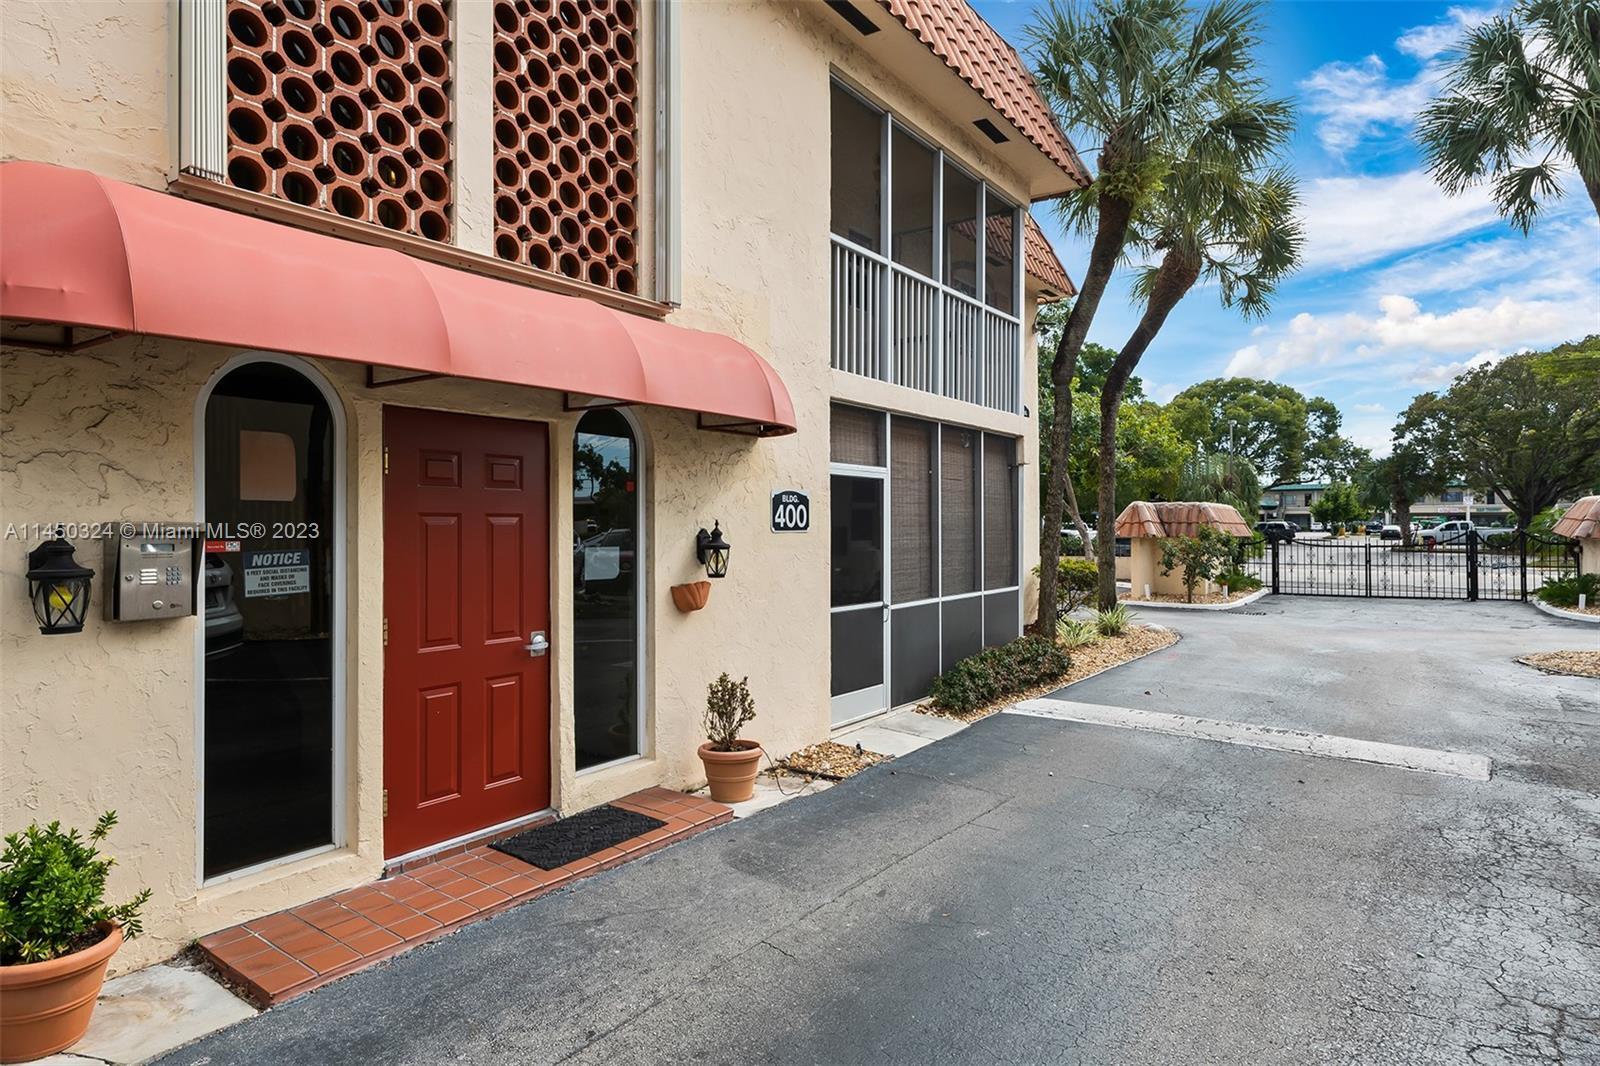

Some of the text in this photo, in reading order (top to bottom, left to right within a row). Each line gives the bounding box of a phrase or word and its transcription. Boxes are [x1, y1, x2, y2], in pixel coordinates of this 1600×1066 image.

[782, 494, 800, 502] BLDG.
[774, 504, 807, 528] 400
[252, 552, 302, 566] NOTICE
